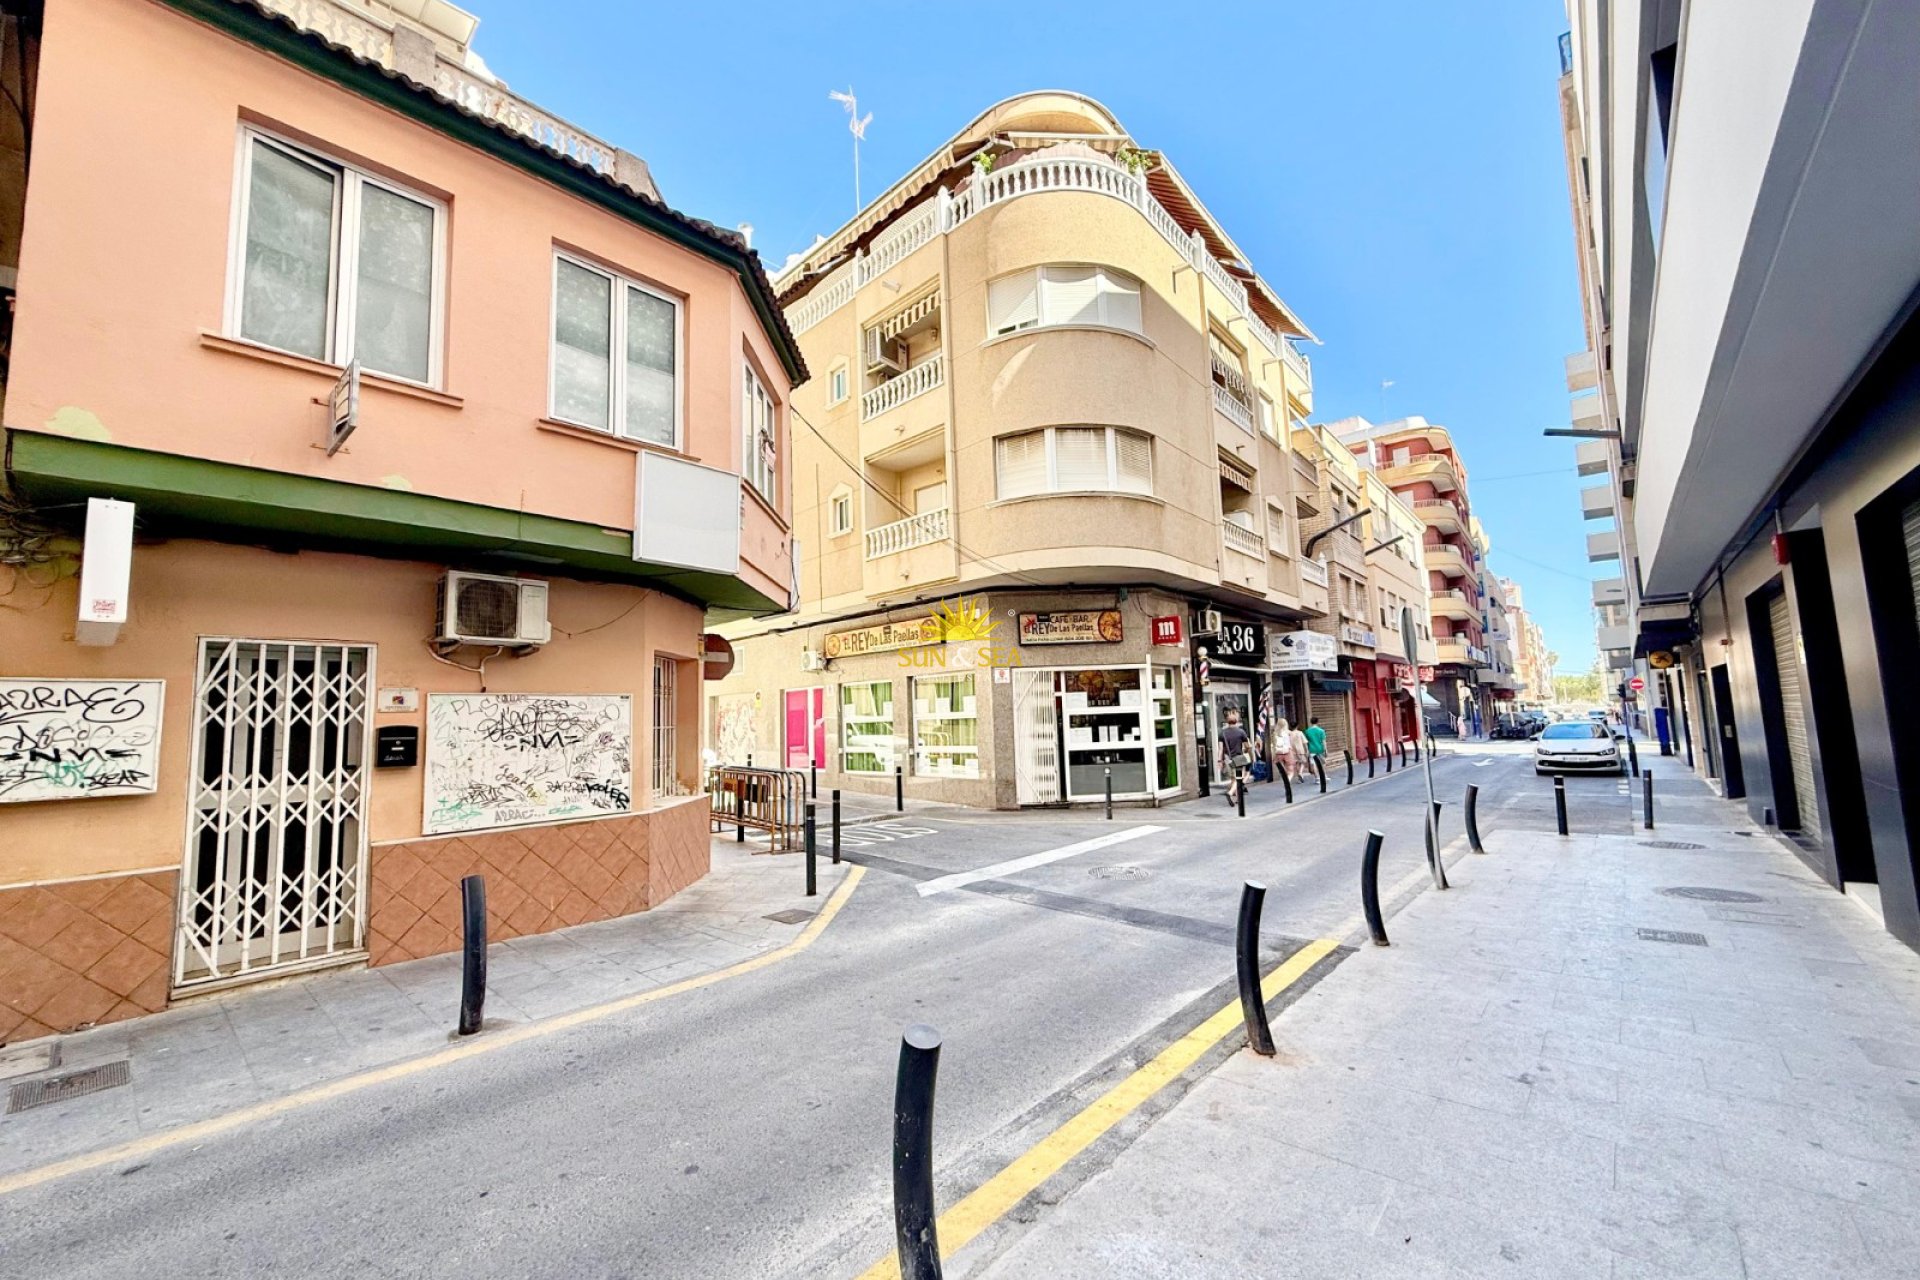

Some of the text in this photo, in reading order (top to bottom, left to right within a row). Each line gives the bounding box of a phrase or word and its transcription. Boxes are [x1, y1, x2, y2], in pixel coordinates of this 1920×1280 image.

[852, 631, 870, 652] REY
[893, 628, 919, 643] Paellas
[1032, 622, 1050, 635] REY
[1232, 625, 1255, 652] 36
